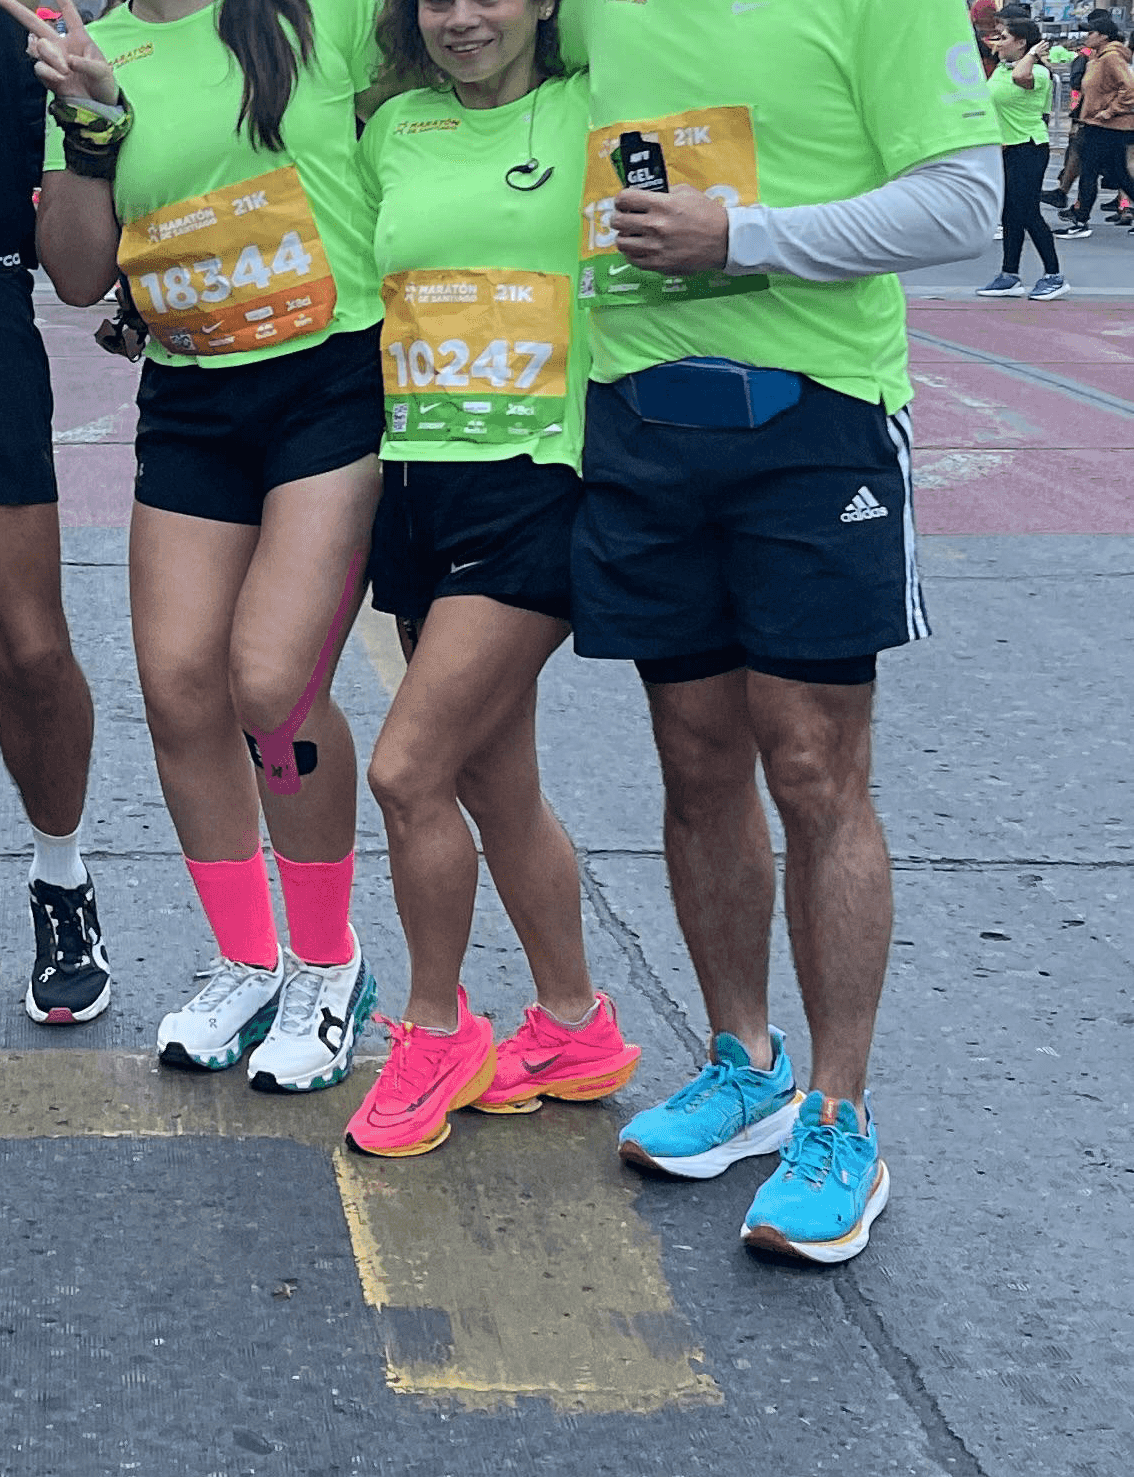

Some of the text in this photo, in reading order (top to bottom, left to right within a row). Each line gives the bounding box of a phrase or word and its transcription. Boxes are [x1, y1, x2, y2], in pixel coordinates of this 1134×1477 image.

[673, 125, 711, 146] 21K
[627, 167, 655, 183] GEL
[232, 190, 268, 216] 21K
[140, 229, 312, 313] 18344
[494, 284, 534, 303] 21K
[388, 338, 554, 389] 10247
[840, 506, 889, 523] adidas
